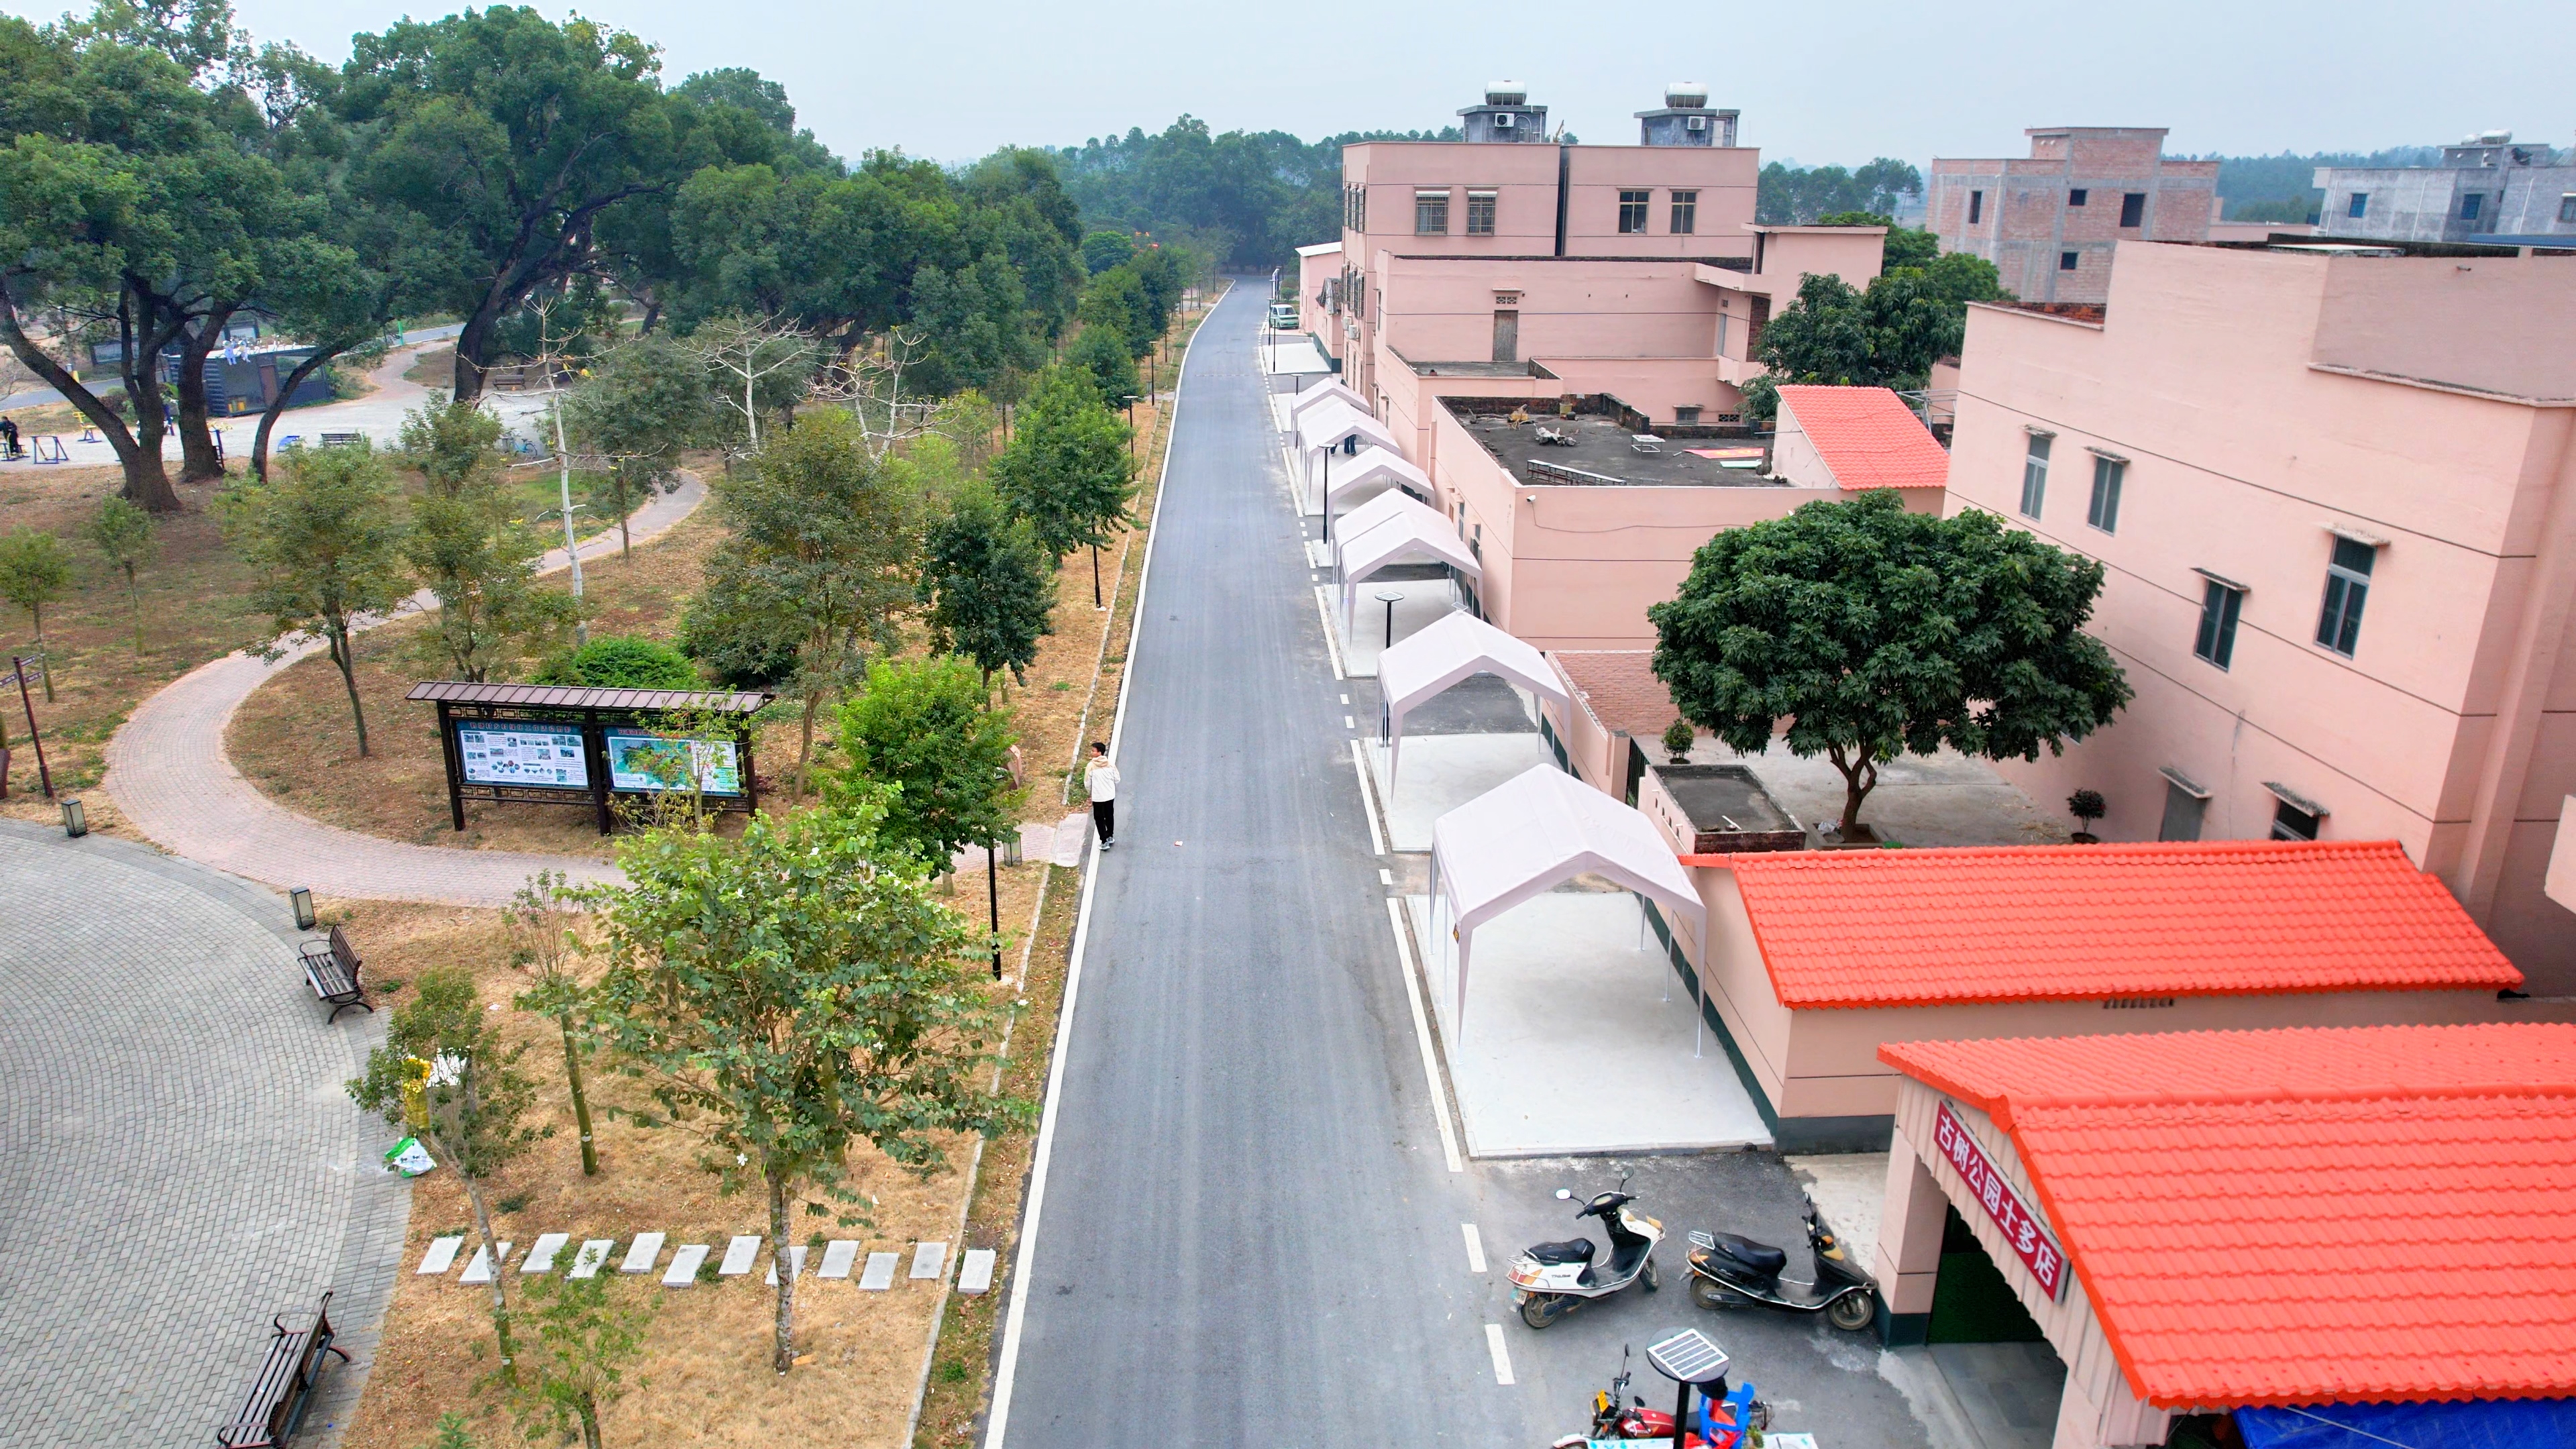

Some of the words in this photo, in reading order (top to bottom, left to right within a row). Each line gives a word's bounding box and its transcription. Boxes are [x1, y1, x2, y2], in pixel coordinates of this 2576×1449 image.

[1939, 1114, 2057, 1287] 古树公园士多店
